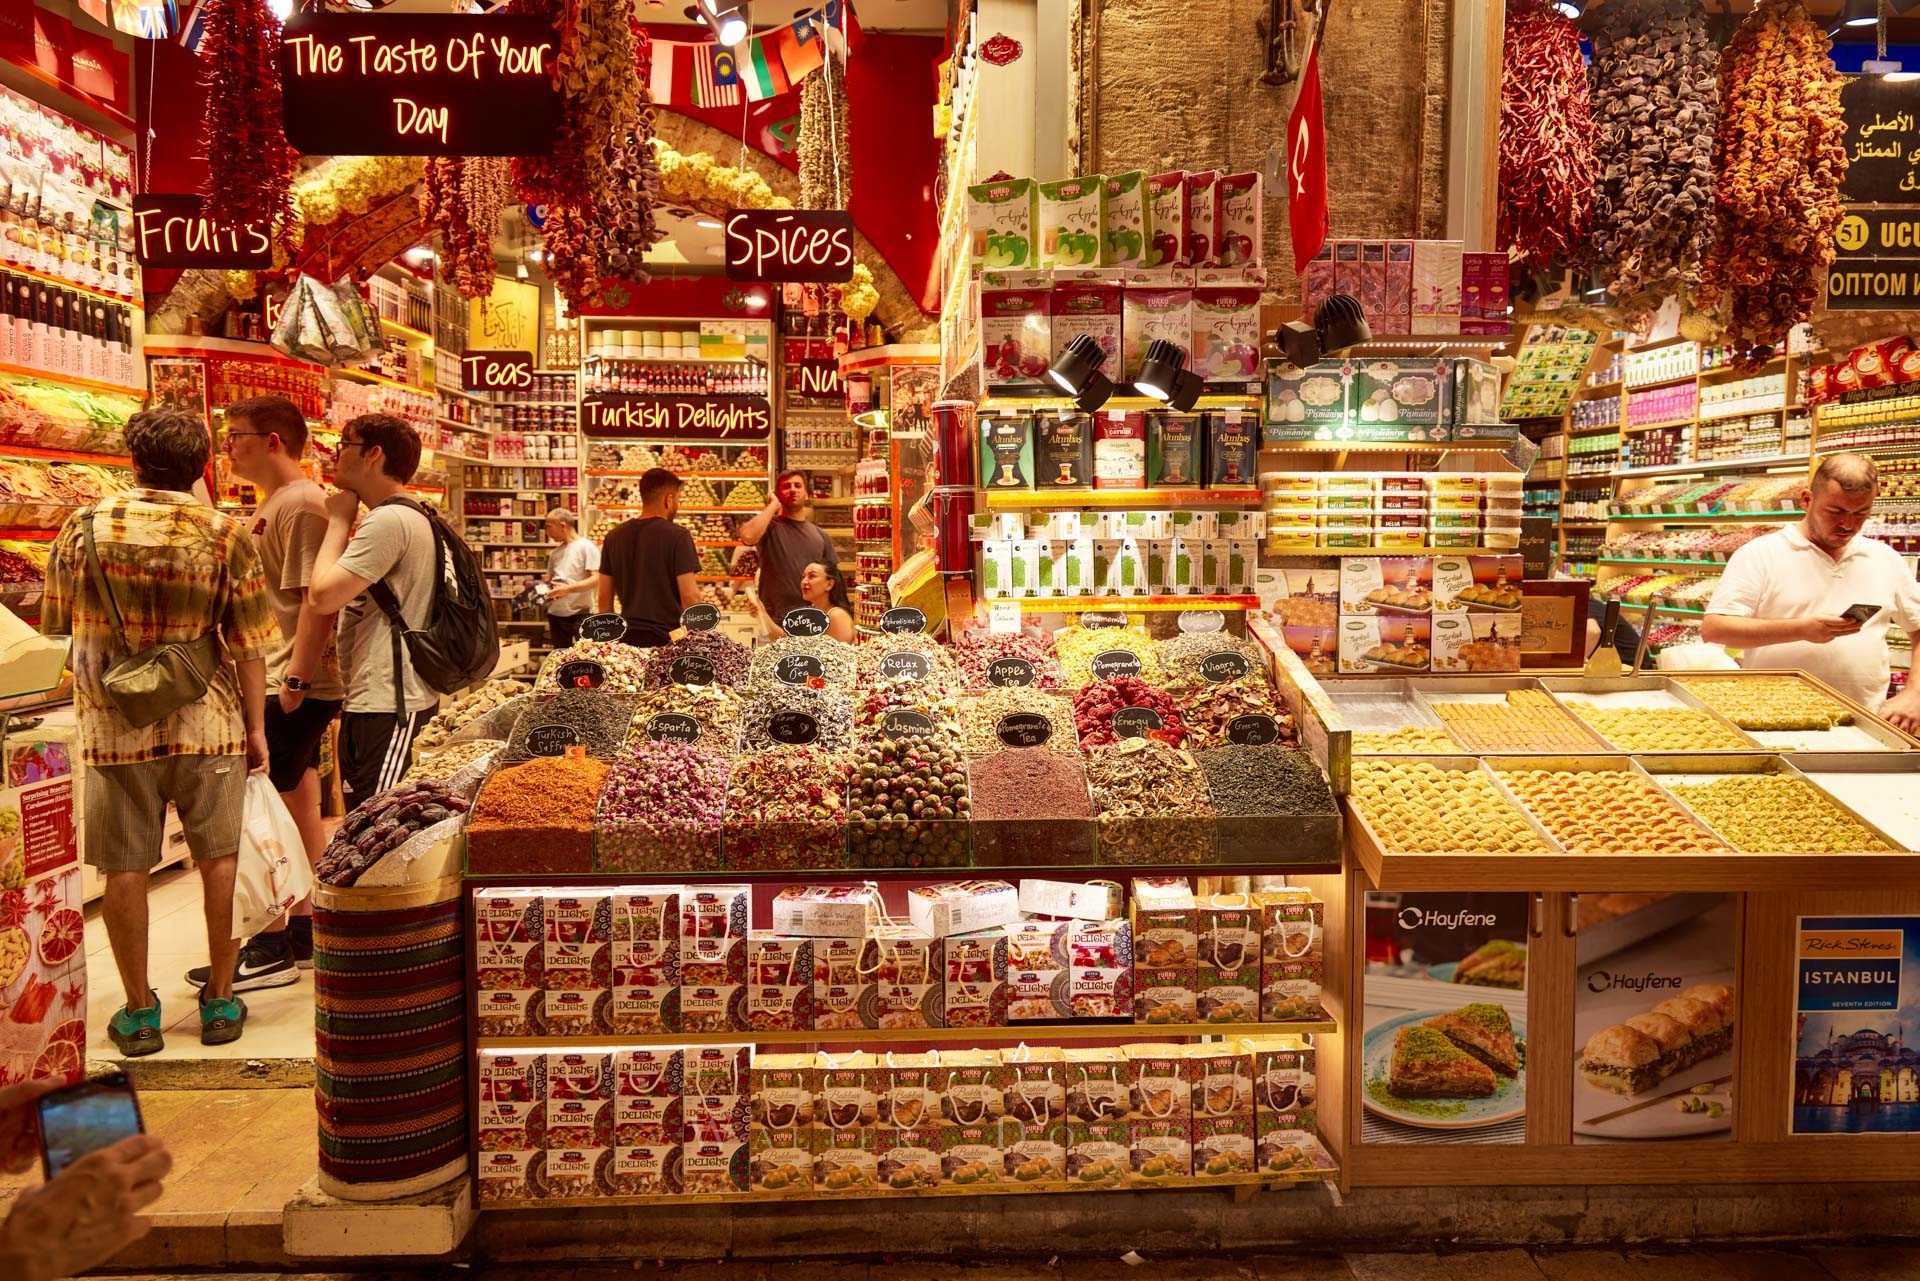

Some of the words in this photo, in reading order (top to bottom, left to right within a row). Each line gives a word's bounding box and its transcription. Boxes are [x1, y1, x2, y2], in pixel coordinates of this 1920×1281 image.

[284, 34, 344, 75] The
[349, 36, 437, 75] Taste
[447, 33, 485, 79] Of
[491, 36, 551, 75] Your
[393, 98, 448, 144] Day
[1841, 222, 1864, 243] 51
[727, 214, 851, 277] Spices
[1829, 273, 1906, 297] ОПТОМ
[463, 356, 531, 387] Teas
[584, 400, 669, 428] Turkish
[676, 402, 769, 438] Delights
[788, 615, 811, 628] Detox
[808, 622, 822, 634] Tea
[887, 659, 918, 669] Relax
[995, 665, 1025, 677] Apple
[1205, 661, 1236, 674] Viagra
[651, 720, 691, 733] Isparta
[887, 718, 931, 735] Jasmine
[1117, 716, 1149, 731] Energy
[1020, 732, 1037, 743] Tea
[1425, 909, 1496, 930] Hayfene
[1805, 937, 1842, 951] Rick
[1844, 937, 1896, 952] Steves
[1612, 973, 1682, 993] Hayfene
[1804, 971, 1896, 984] ISTANBUL
